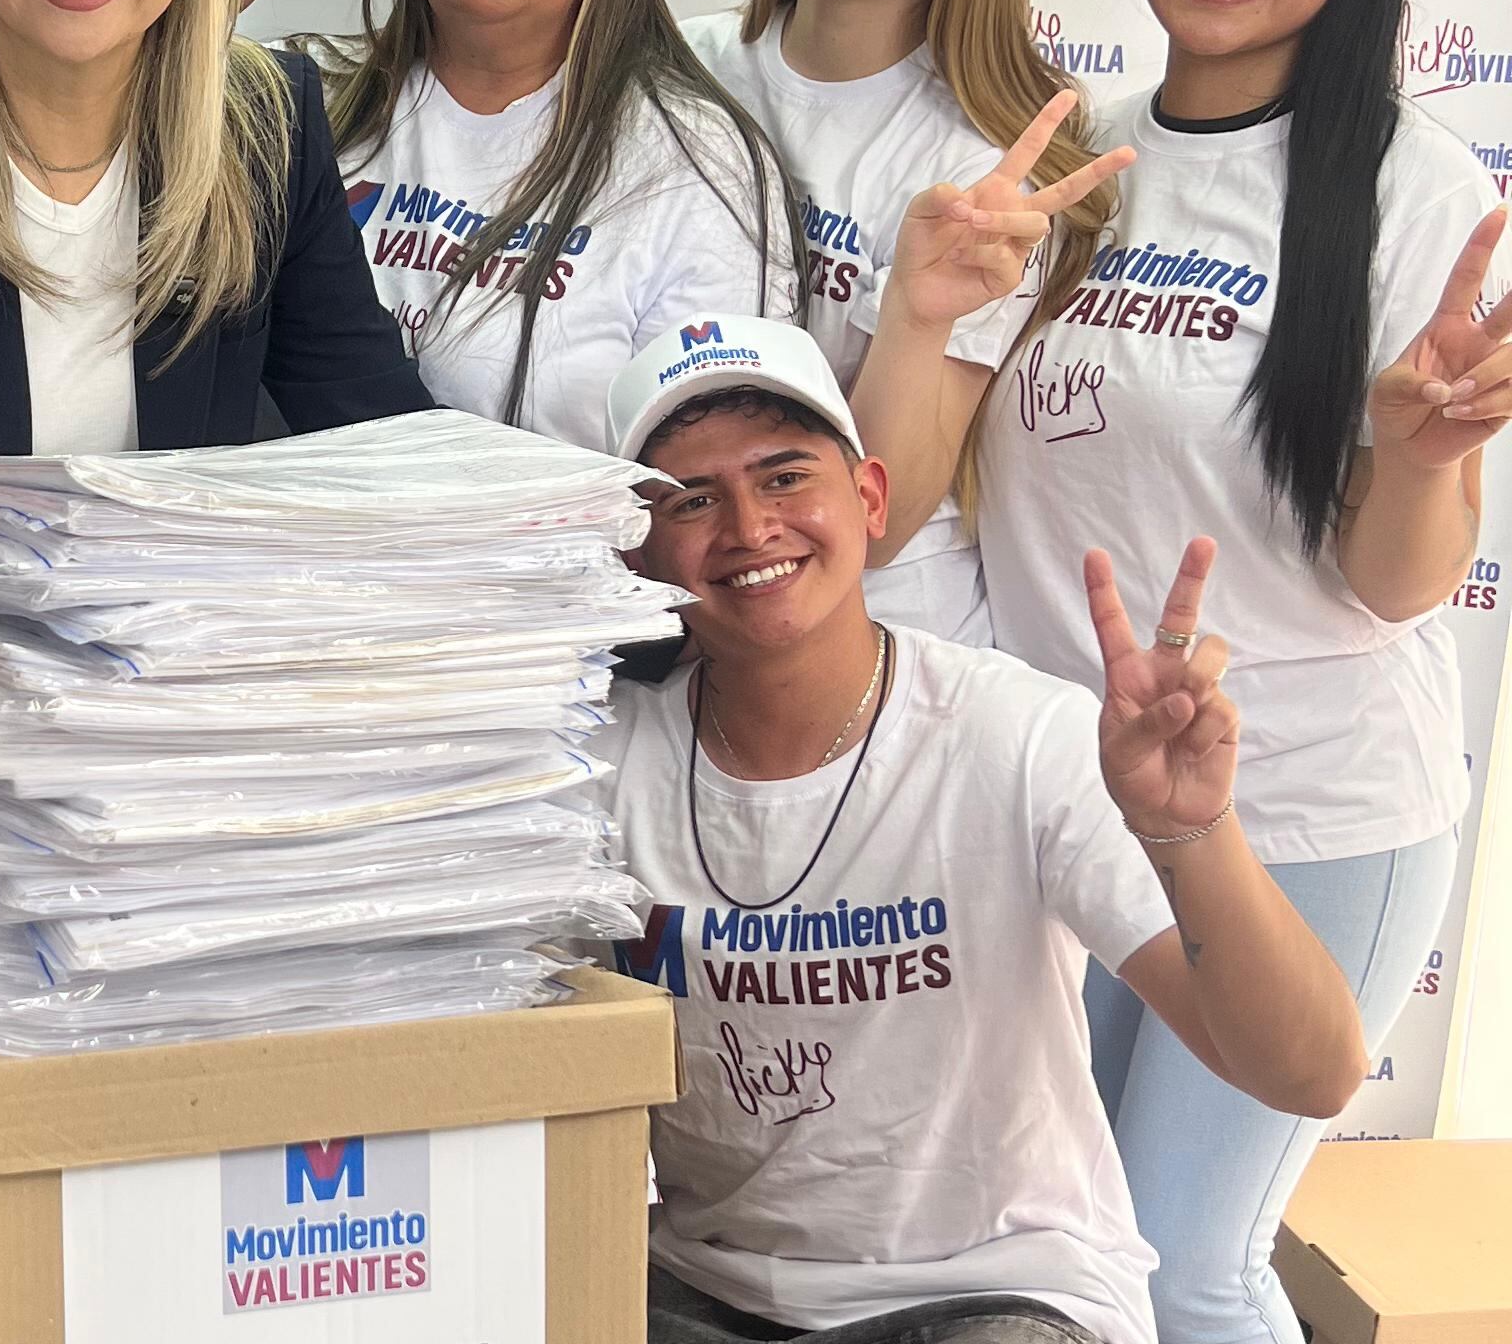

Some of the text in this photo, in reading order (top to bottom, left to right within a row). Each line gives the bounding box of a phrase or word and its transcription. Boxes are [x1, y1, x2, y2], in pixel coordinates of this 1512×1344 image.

[701, 898, 946, 953] Movimiento
[704, 944, 951, 1005] VALIENTES
[226, 1209, 426, 1265] Movimiento
[227, 1250, 427, 1309] VALIENTES
